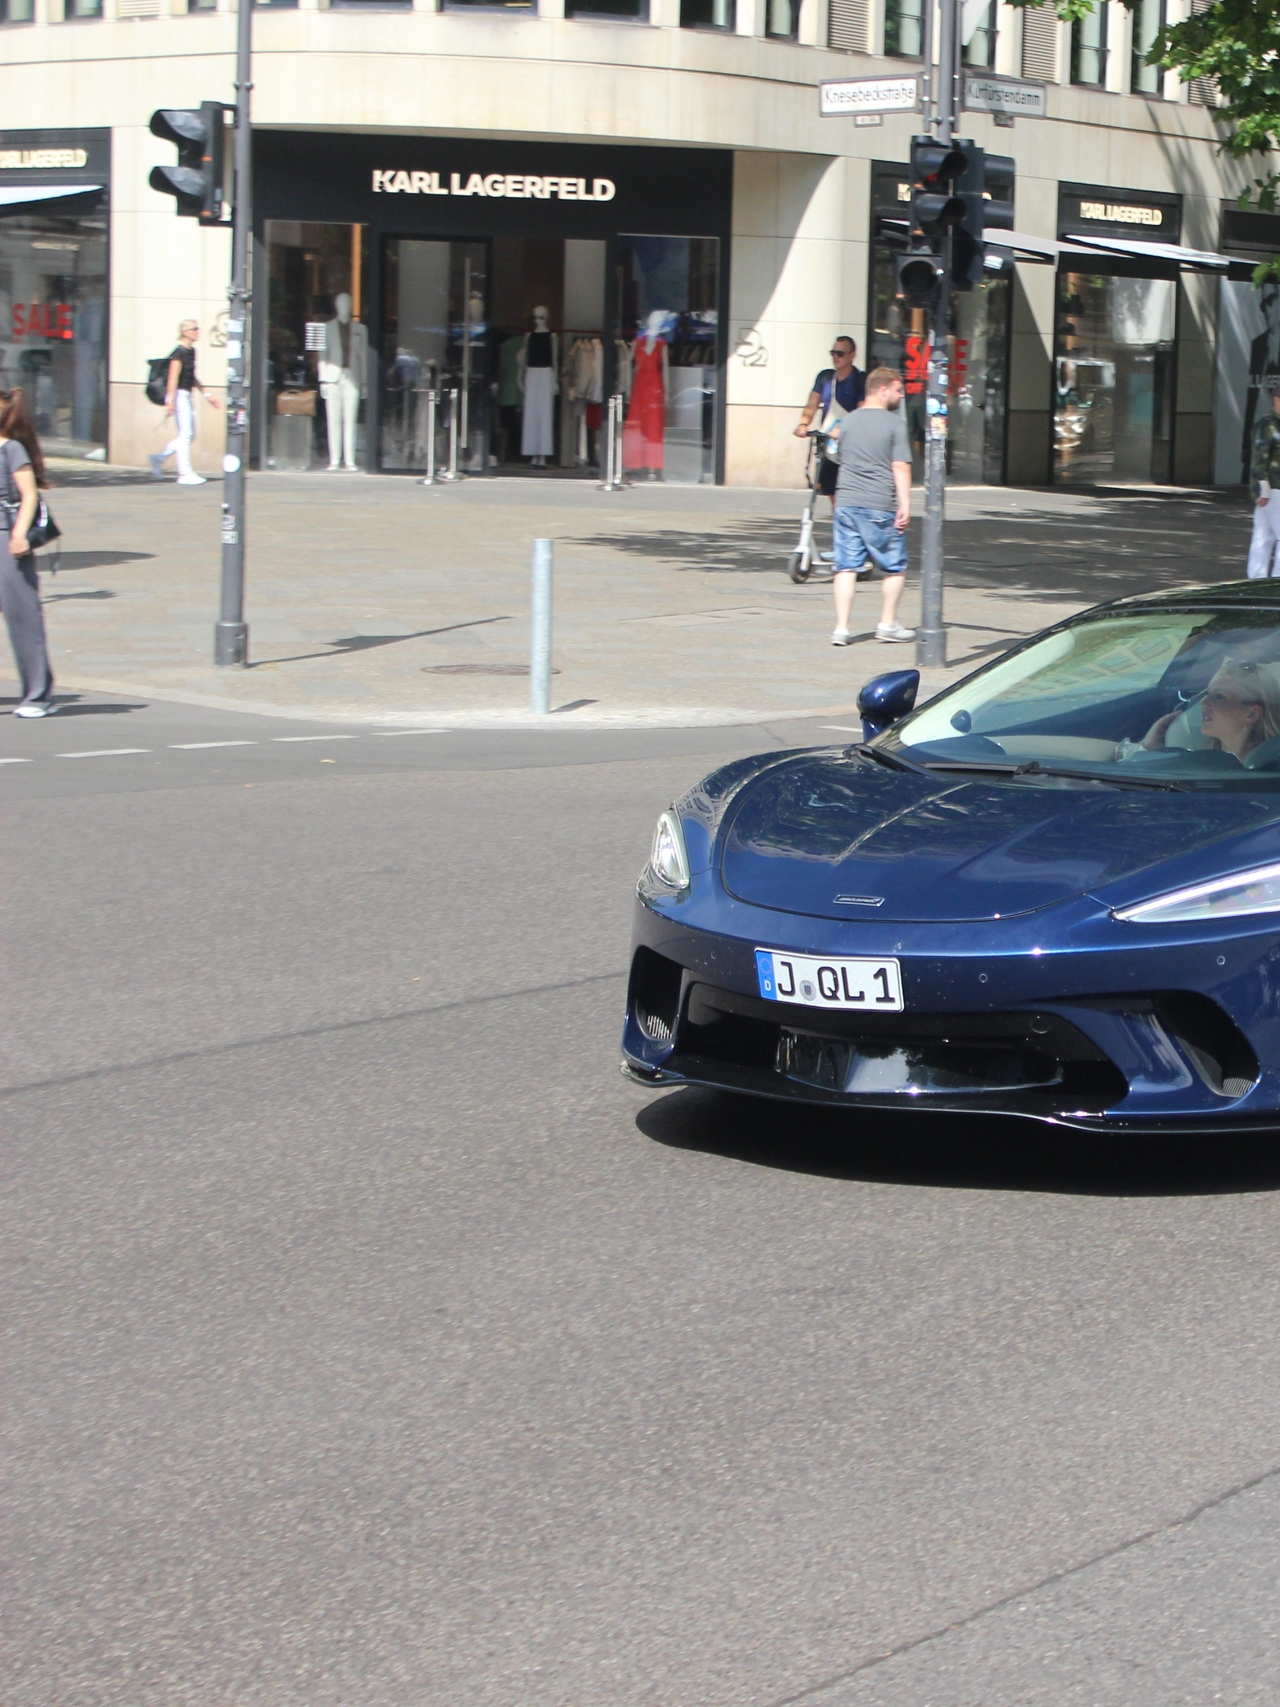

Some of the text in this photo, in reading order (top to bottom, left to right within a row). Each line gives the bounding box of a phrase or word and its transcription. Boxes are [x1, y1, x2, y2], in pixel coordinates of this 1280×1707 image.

[823, 83, 915, 104] Knesebeckstraße
[967, 82, 1041, 106] Kurfürstendamm
[372, 170, 616, 201] KARL LAGERFELD
[12, 303, 74, 339] SALE
[778, 961, 896, 1003] J QL 1
